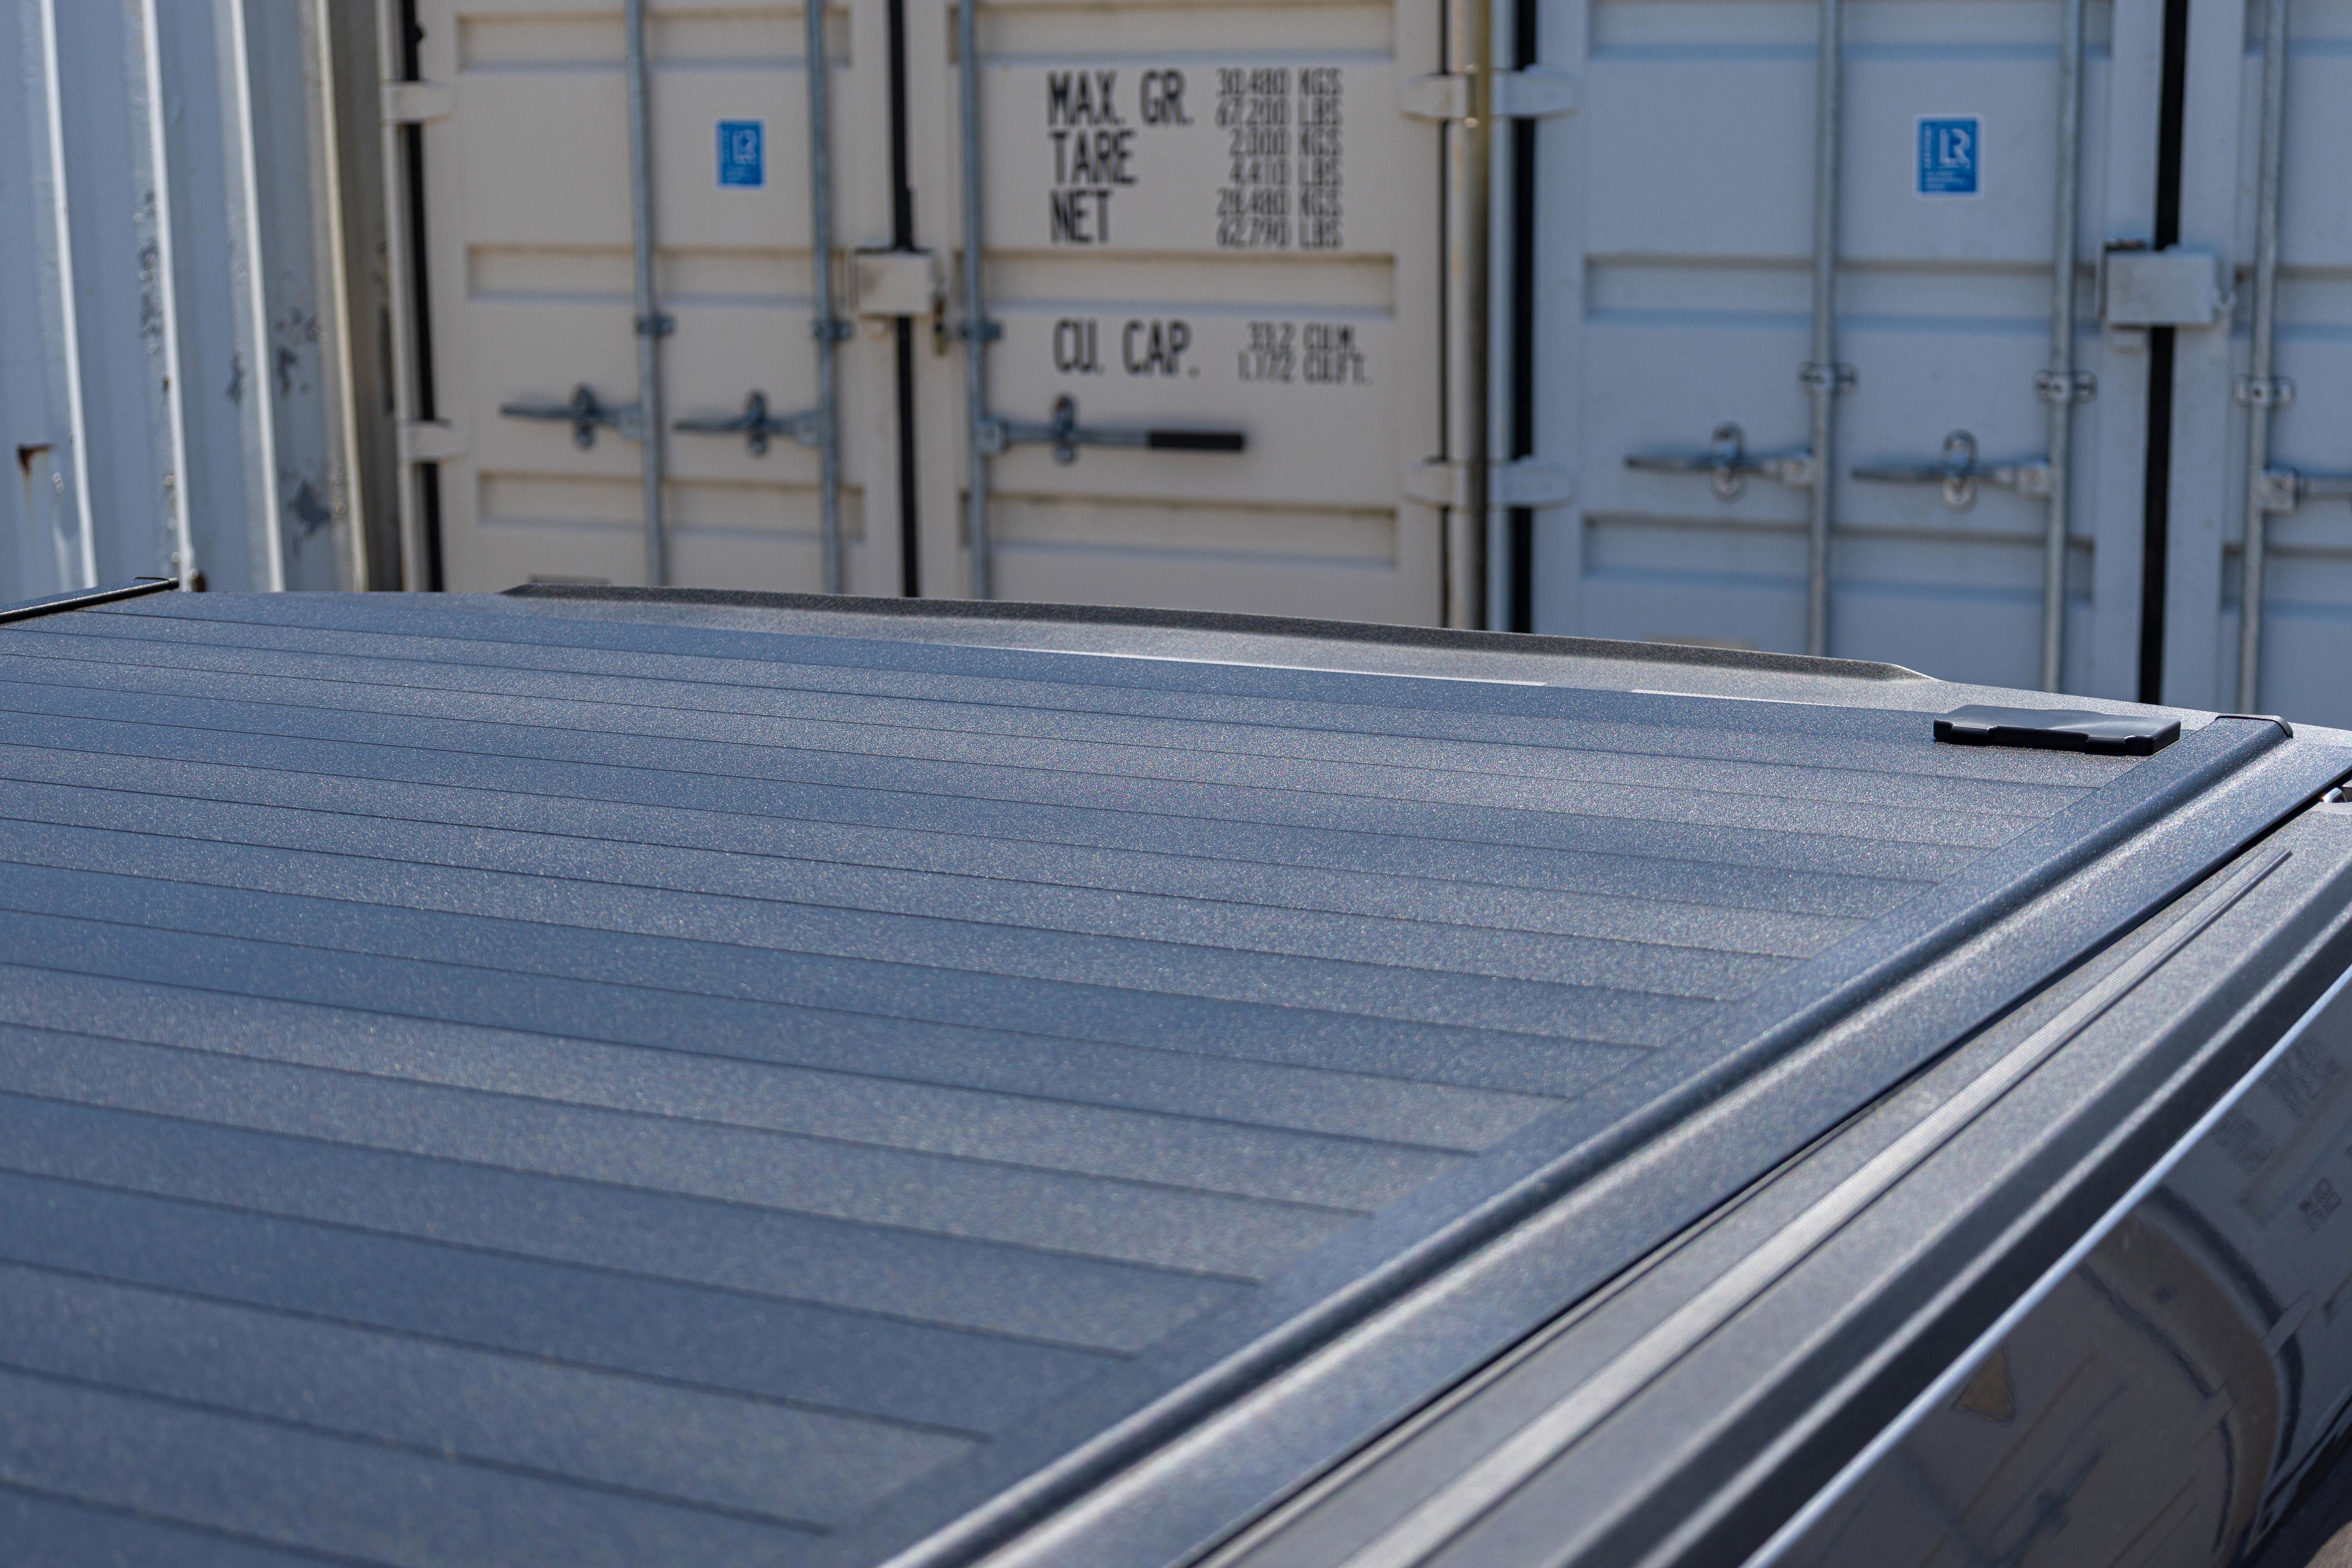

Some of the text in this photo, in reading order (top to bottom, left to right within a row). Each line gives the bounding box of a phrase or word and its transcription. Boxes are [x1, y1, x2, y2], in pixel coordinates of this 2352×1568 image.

[1140, 68, 1195, 126] GR.
[1049, 129, 1138, 185] TARE
[1940, 128, 1971, 168] LR
[1049, 188, 1112, 244] NET
[1052, 318, 1105, 375] CU.
[1122, 320, 1200, 377] CAP.
